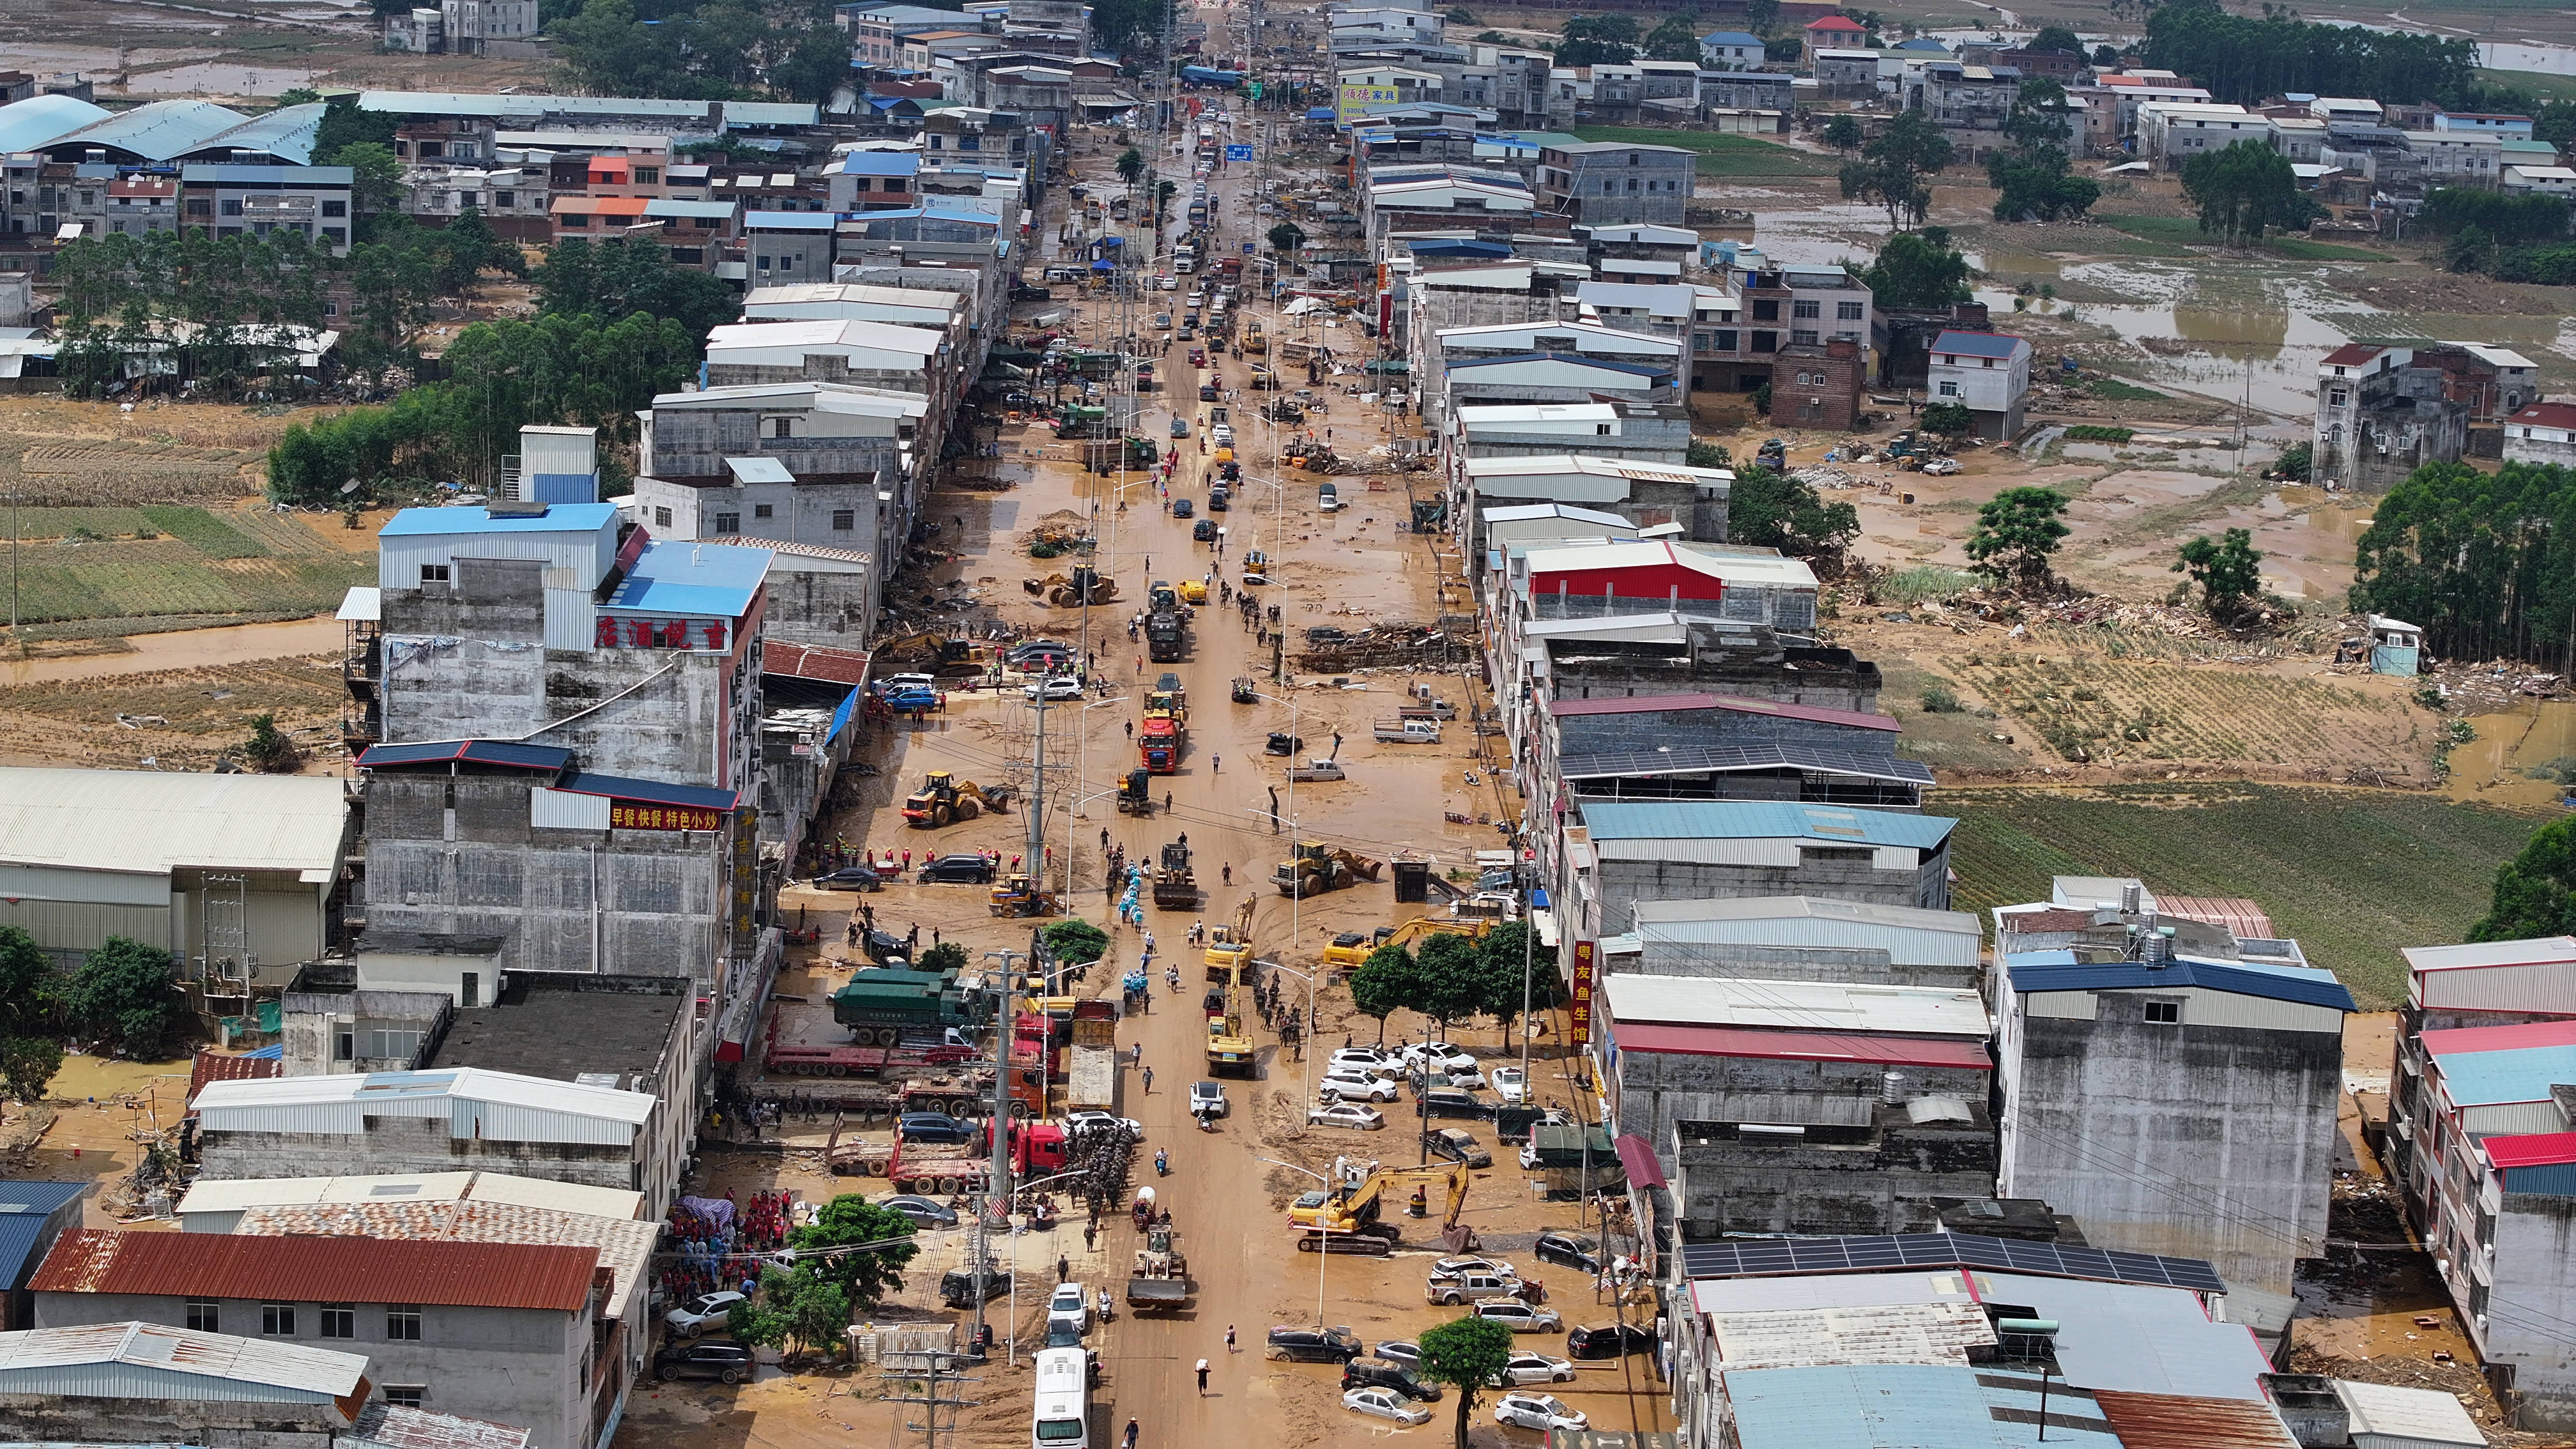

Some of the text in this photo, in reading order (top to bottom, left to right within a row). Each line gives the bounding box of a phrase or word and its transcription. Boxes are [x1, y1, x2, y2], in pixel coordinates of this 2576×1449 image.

[1573, 946, 1591, 1041] 粤友鱼生馆
